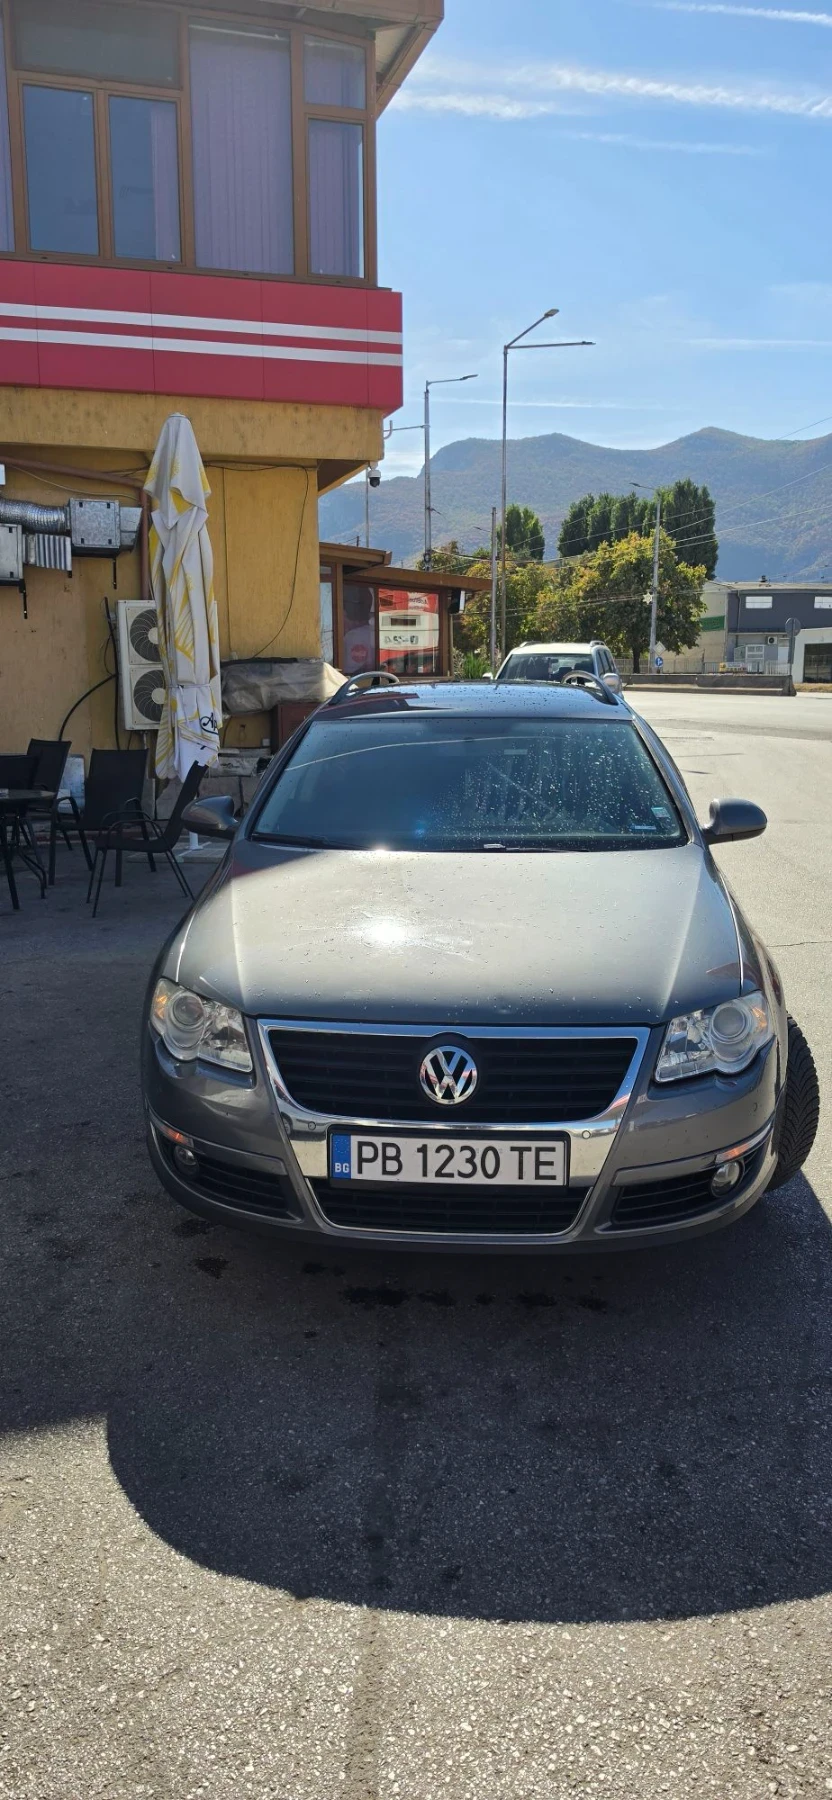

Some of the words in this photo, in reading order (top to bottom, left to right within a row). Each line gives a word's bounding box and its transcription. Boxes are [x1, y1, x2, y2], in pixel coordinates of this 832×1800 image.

[334, 1163, 350, 1173] BG
[357, 1141, 403, 1176] PB
[416, 1144, 501, 1180] 1230
[510, 1146, 557, 1181] TE
